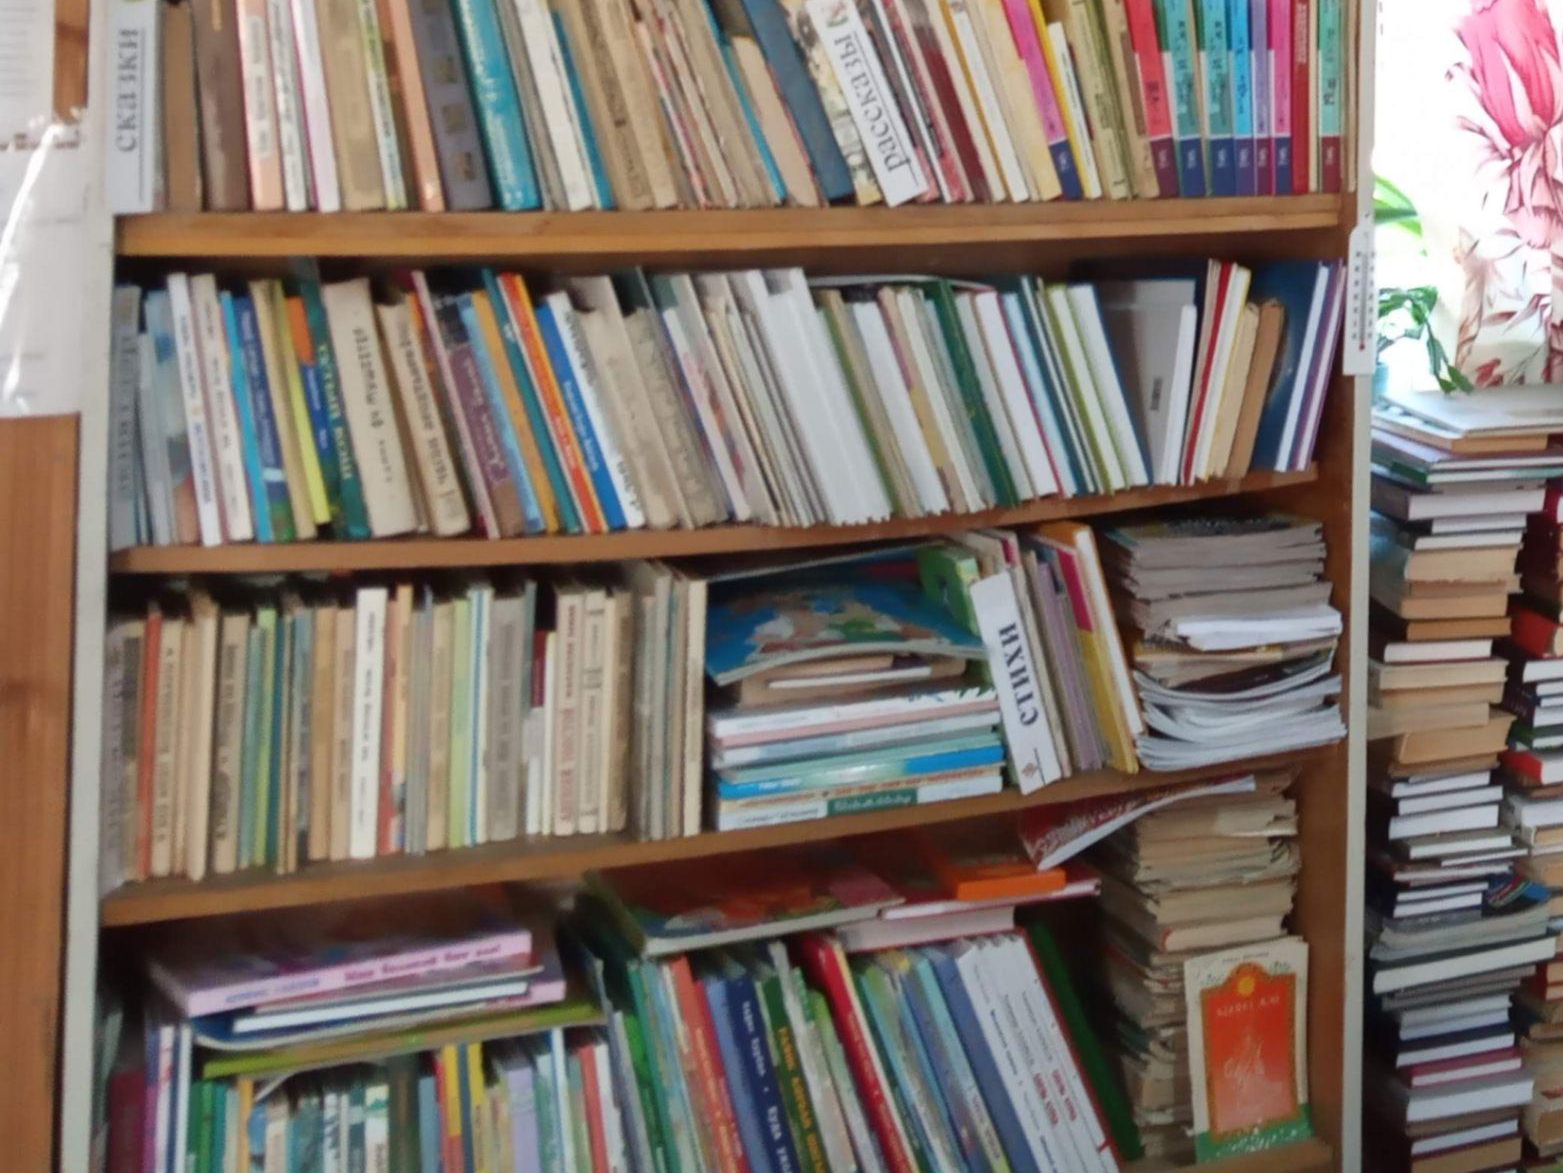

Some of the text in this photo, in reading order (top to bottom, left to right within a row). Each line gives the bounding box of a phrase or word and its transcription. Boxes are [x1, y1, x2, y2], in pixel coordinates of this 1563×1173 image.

[116, 28, 139, 153] сказки
[835, 31, 911, 174] рассказы
[997, 621, 1040, 727] СТИХИ
